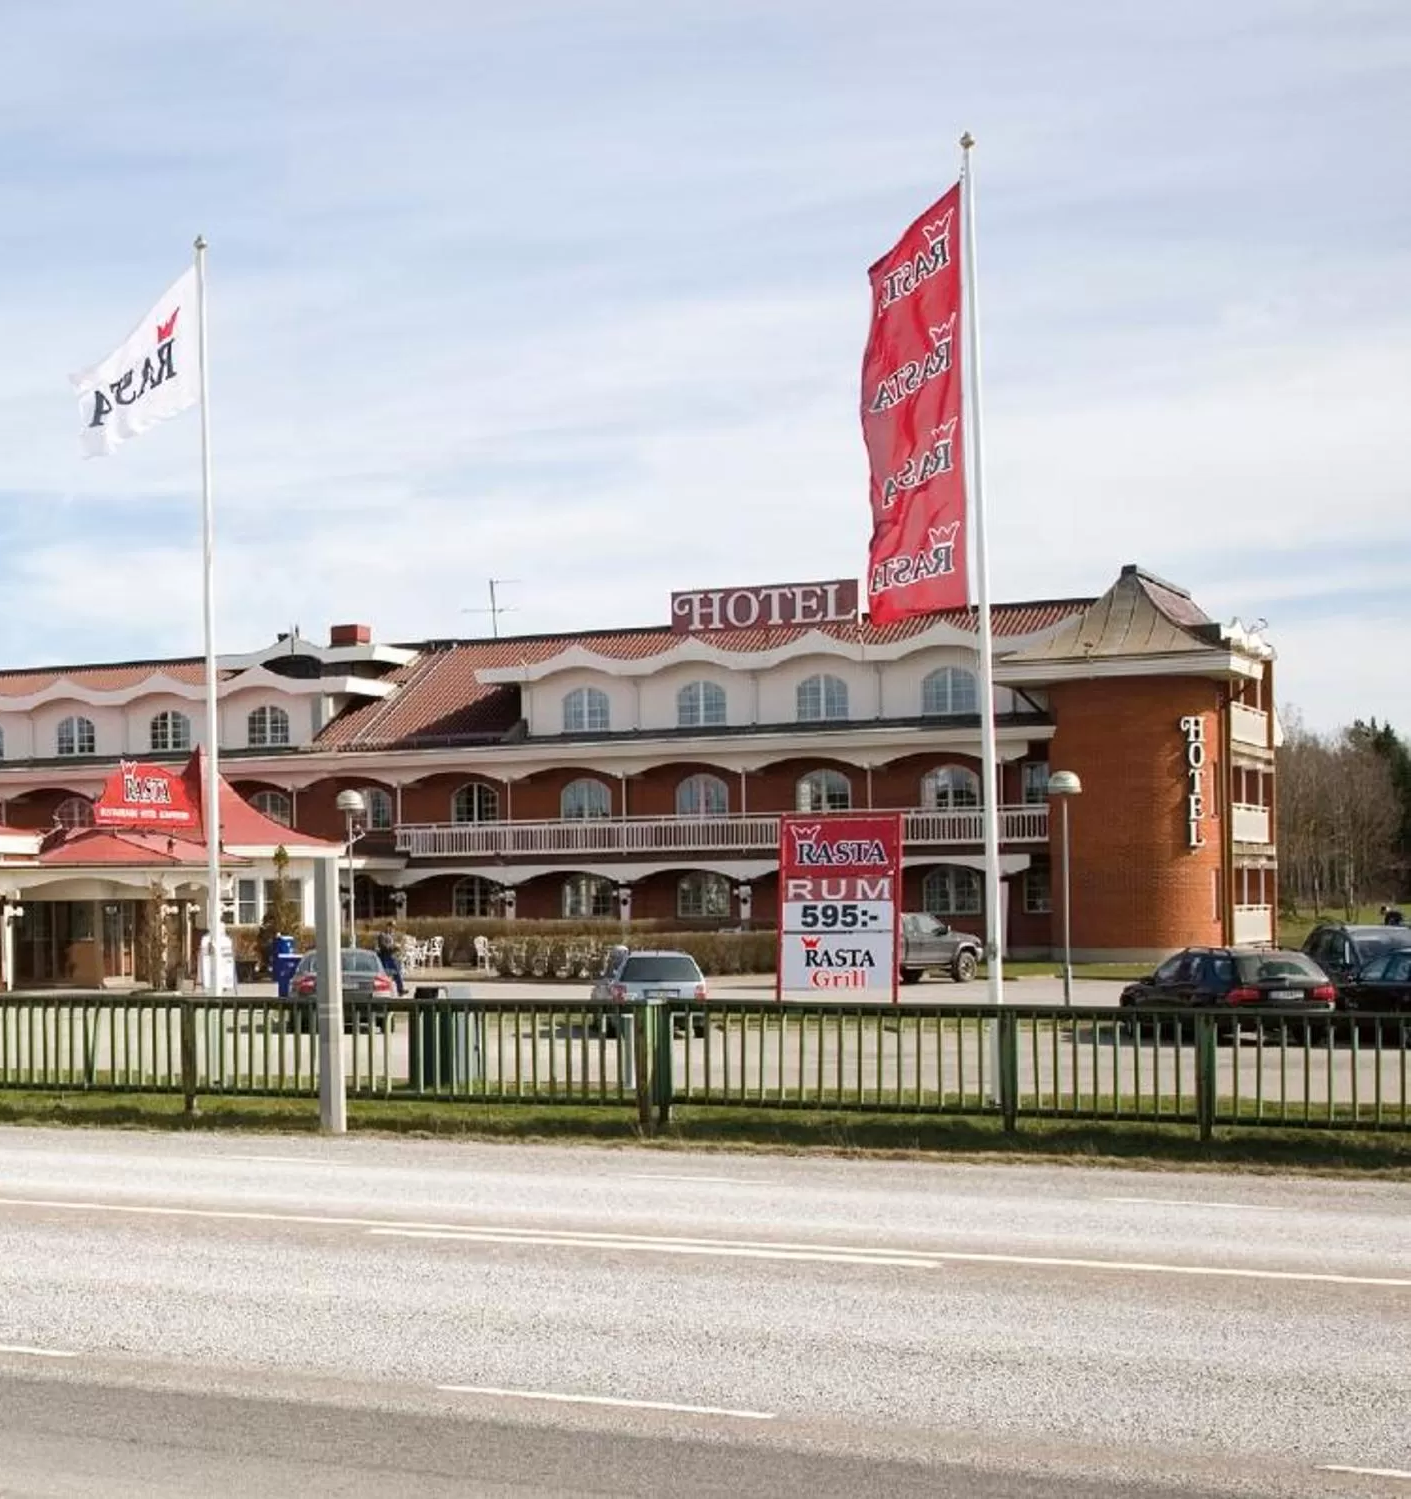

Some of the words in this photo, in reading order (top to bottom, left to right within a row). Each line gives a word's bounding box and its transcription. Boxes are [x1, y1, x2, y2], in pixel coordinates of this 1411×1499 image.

[673, 584, 857, 630] HOTEL
[123, 775, 171, 804] RASTA
[1180, 716, 1207, 847] HOTEL
[795, 839, 888, 865] RASTA
[787, 879, 890, 900] RUM
[801, 904, 879, 928] 595:-
[805, 949, 875, 968] RASTA
[812, 970, 867, 989] Grill
